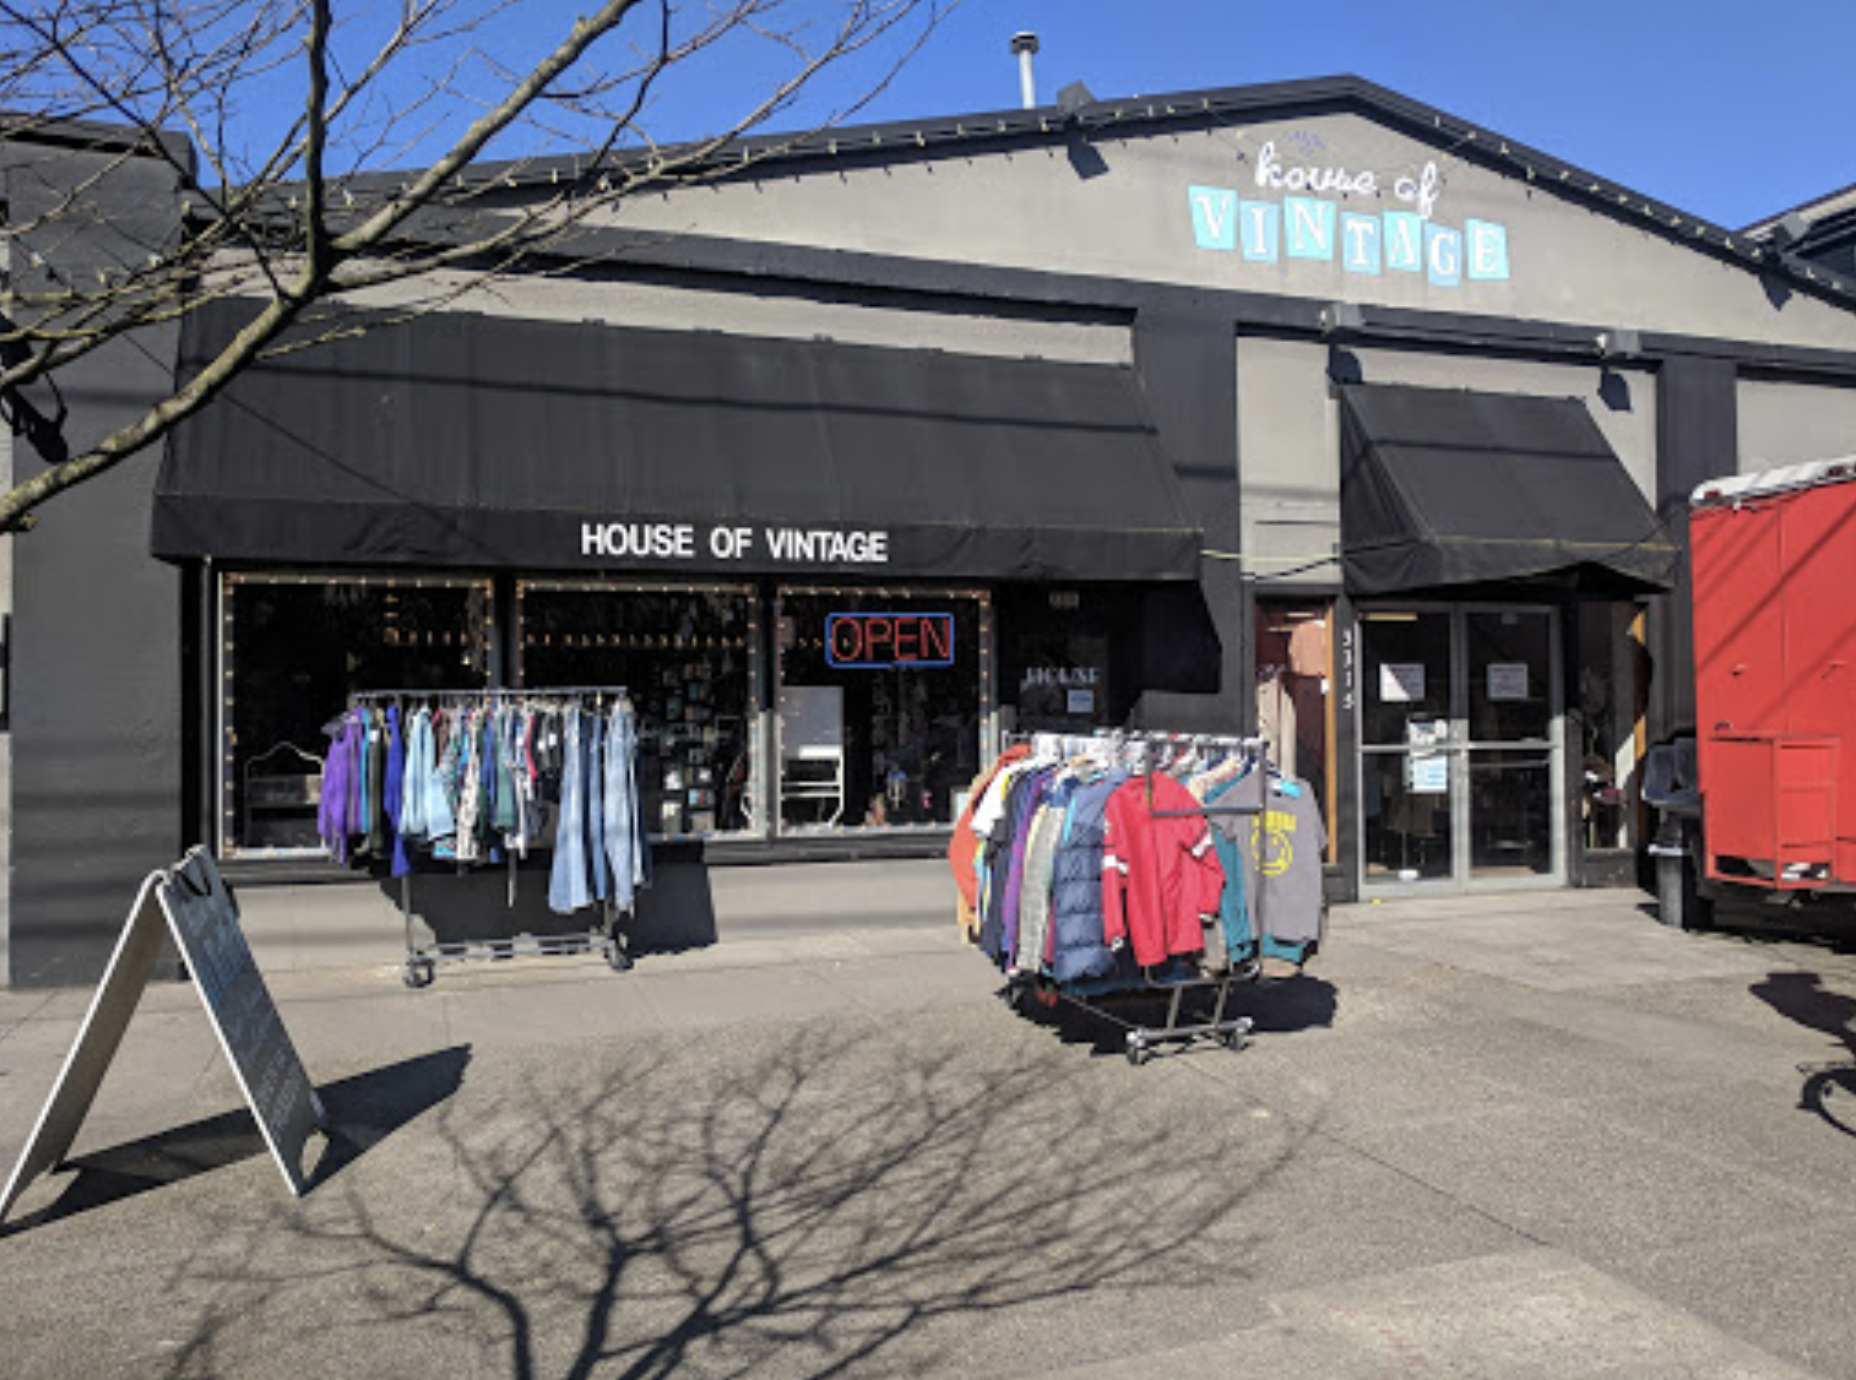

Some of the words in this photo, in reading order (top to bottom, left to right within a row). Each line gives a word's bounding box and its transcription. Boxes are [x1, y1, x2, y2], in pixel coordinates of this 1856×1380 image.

[1254, 141, 1378, 194] house
[1394, 161, 1440, 220] of
[1193, 191, 1501, 279] VINTAGE
[580, 523, 694, 558] HOUSE
[709, 527, 752, 559] OF
[765, 528, 888, 563] VINTAGE
[831, 616, 951, 662] OPEN
